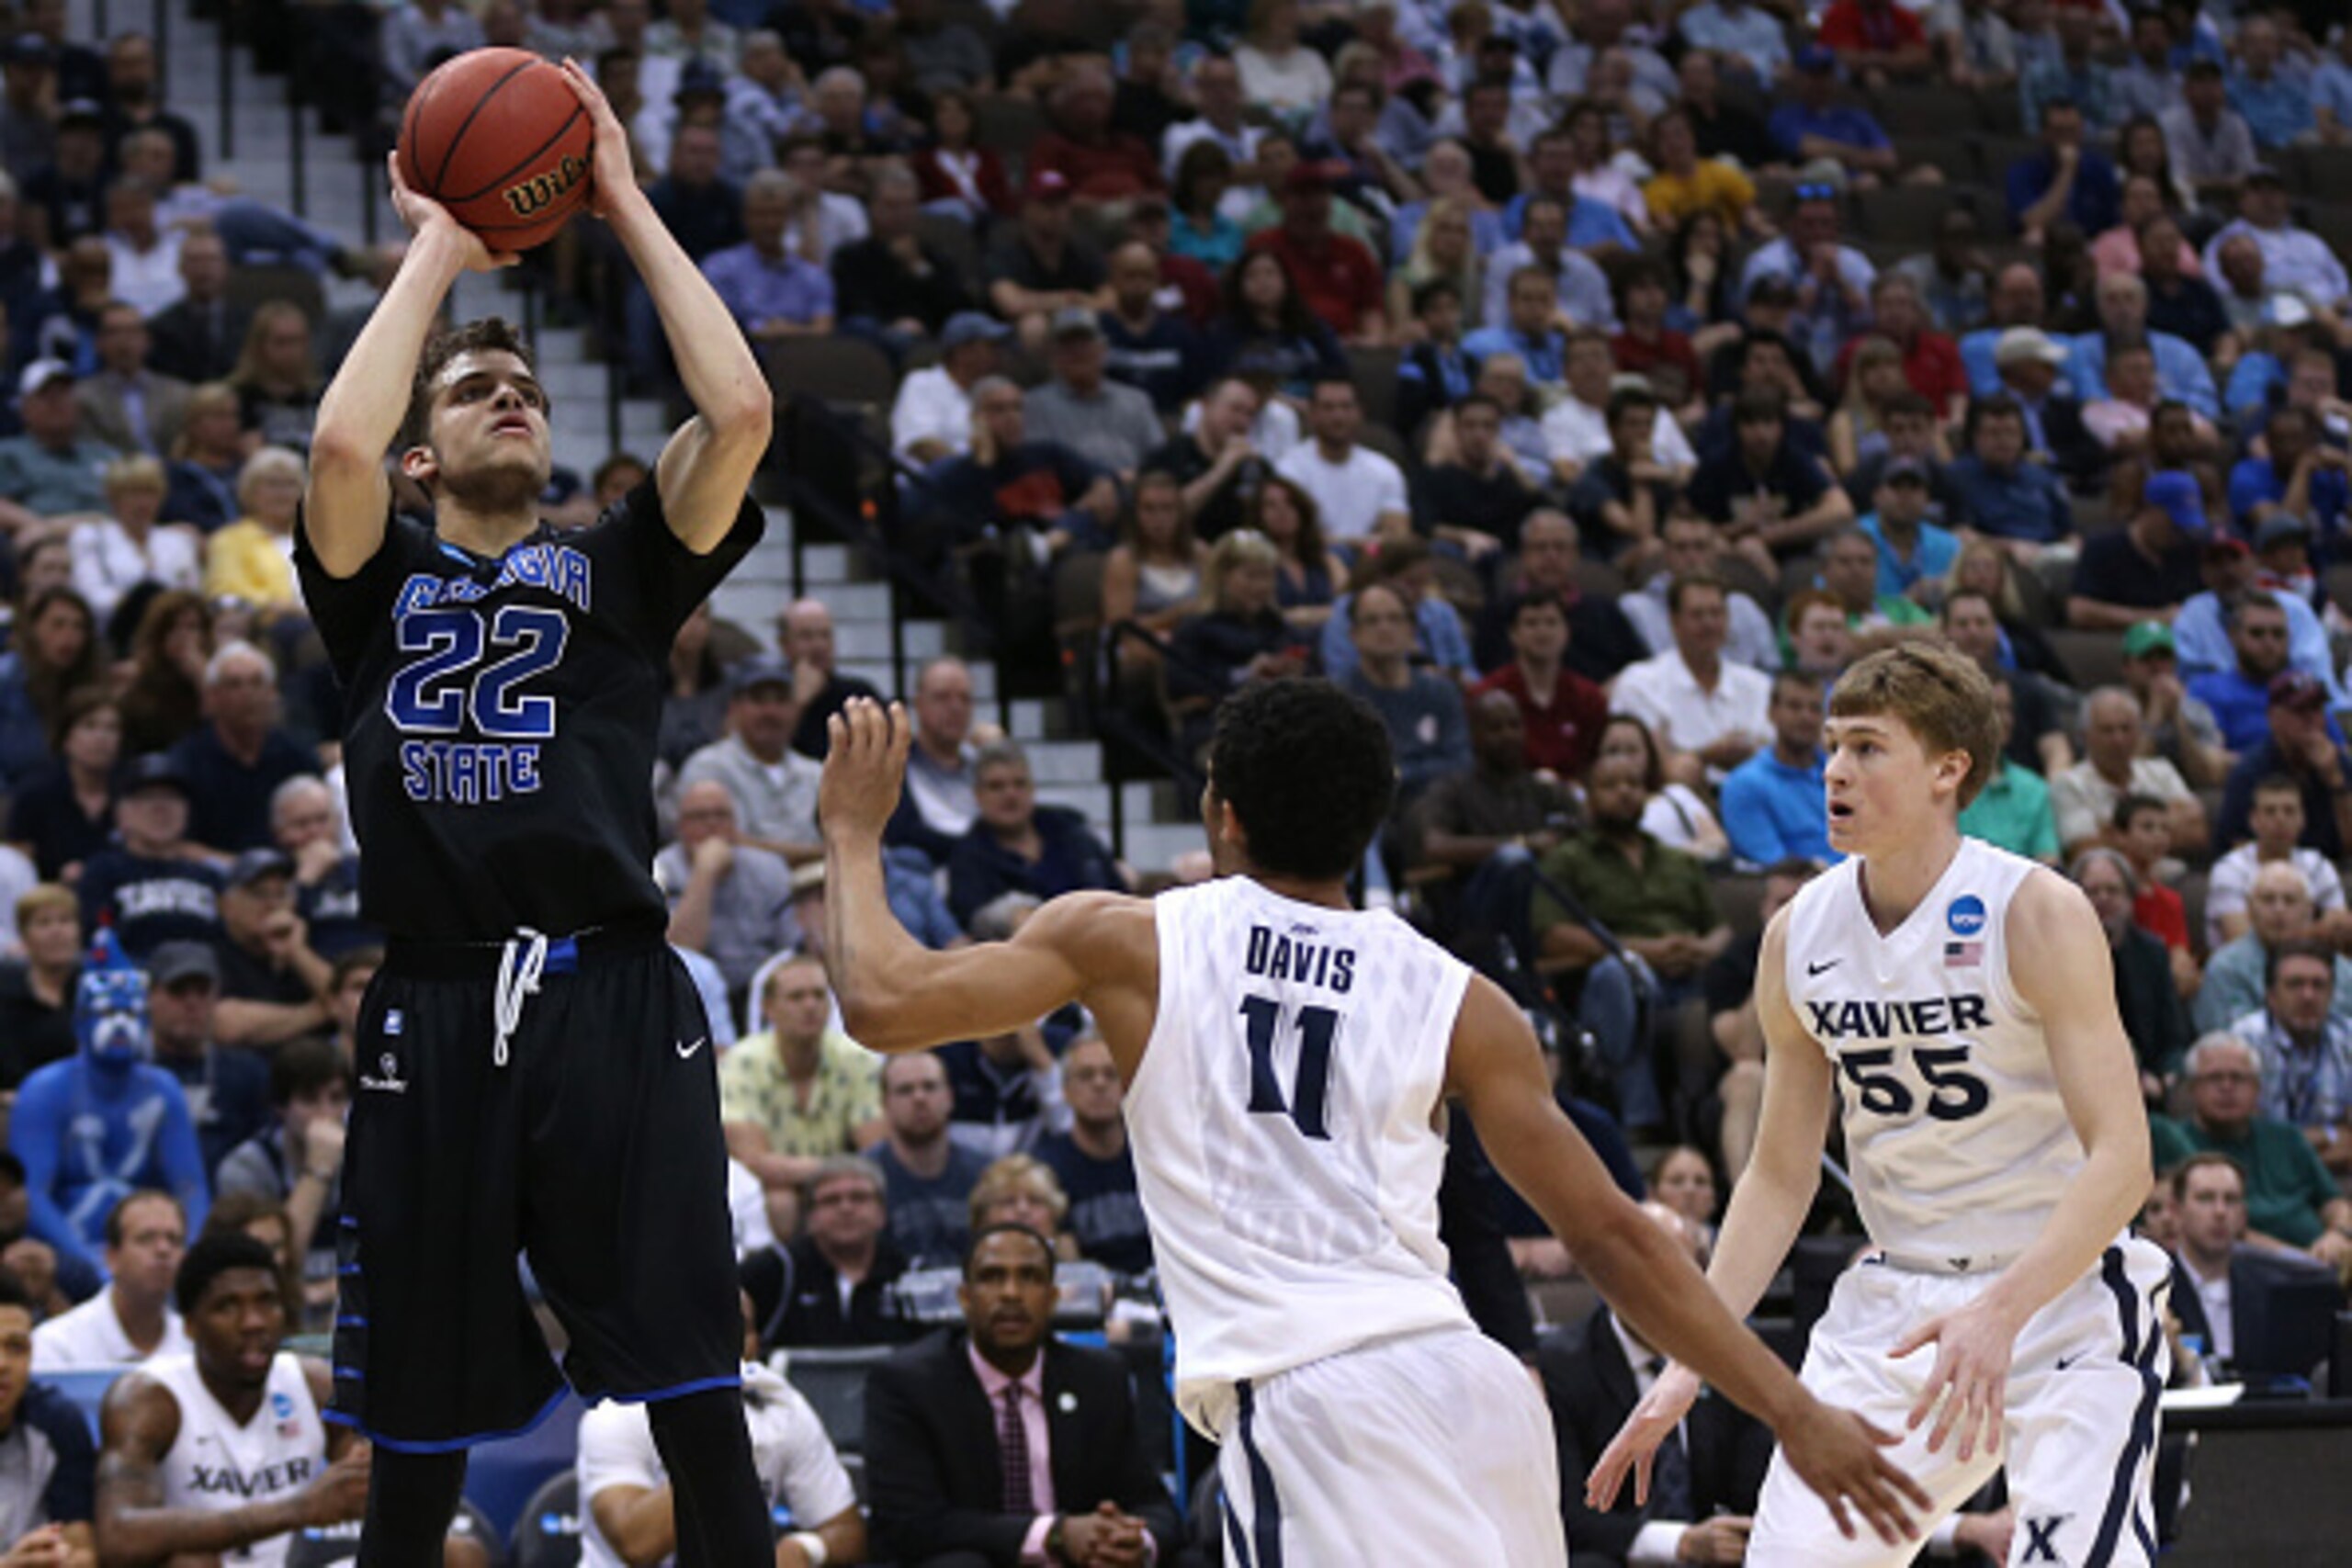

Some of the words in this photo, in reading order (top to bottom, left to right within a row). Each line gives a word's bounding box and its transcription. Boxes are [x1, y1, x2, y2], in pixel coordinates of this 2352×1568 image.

[502, 154, 588, 218] Wil
[384, 604, 571, 738] 22
[399, 739, 542, 805] STATE
[1245, 924, 1356, 995] DAVIS
[1805, 993, 1994, 1039] XAVIER
[1238, 992, 1339, 1141] 11
[1838, 1045, 1990, 1122] 55
[187, 1456, 311, 1498] XAVIER
[2020, 1515, 2071, 1562] X
